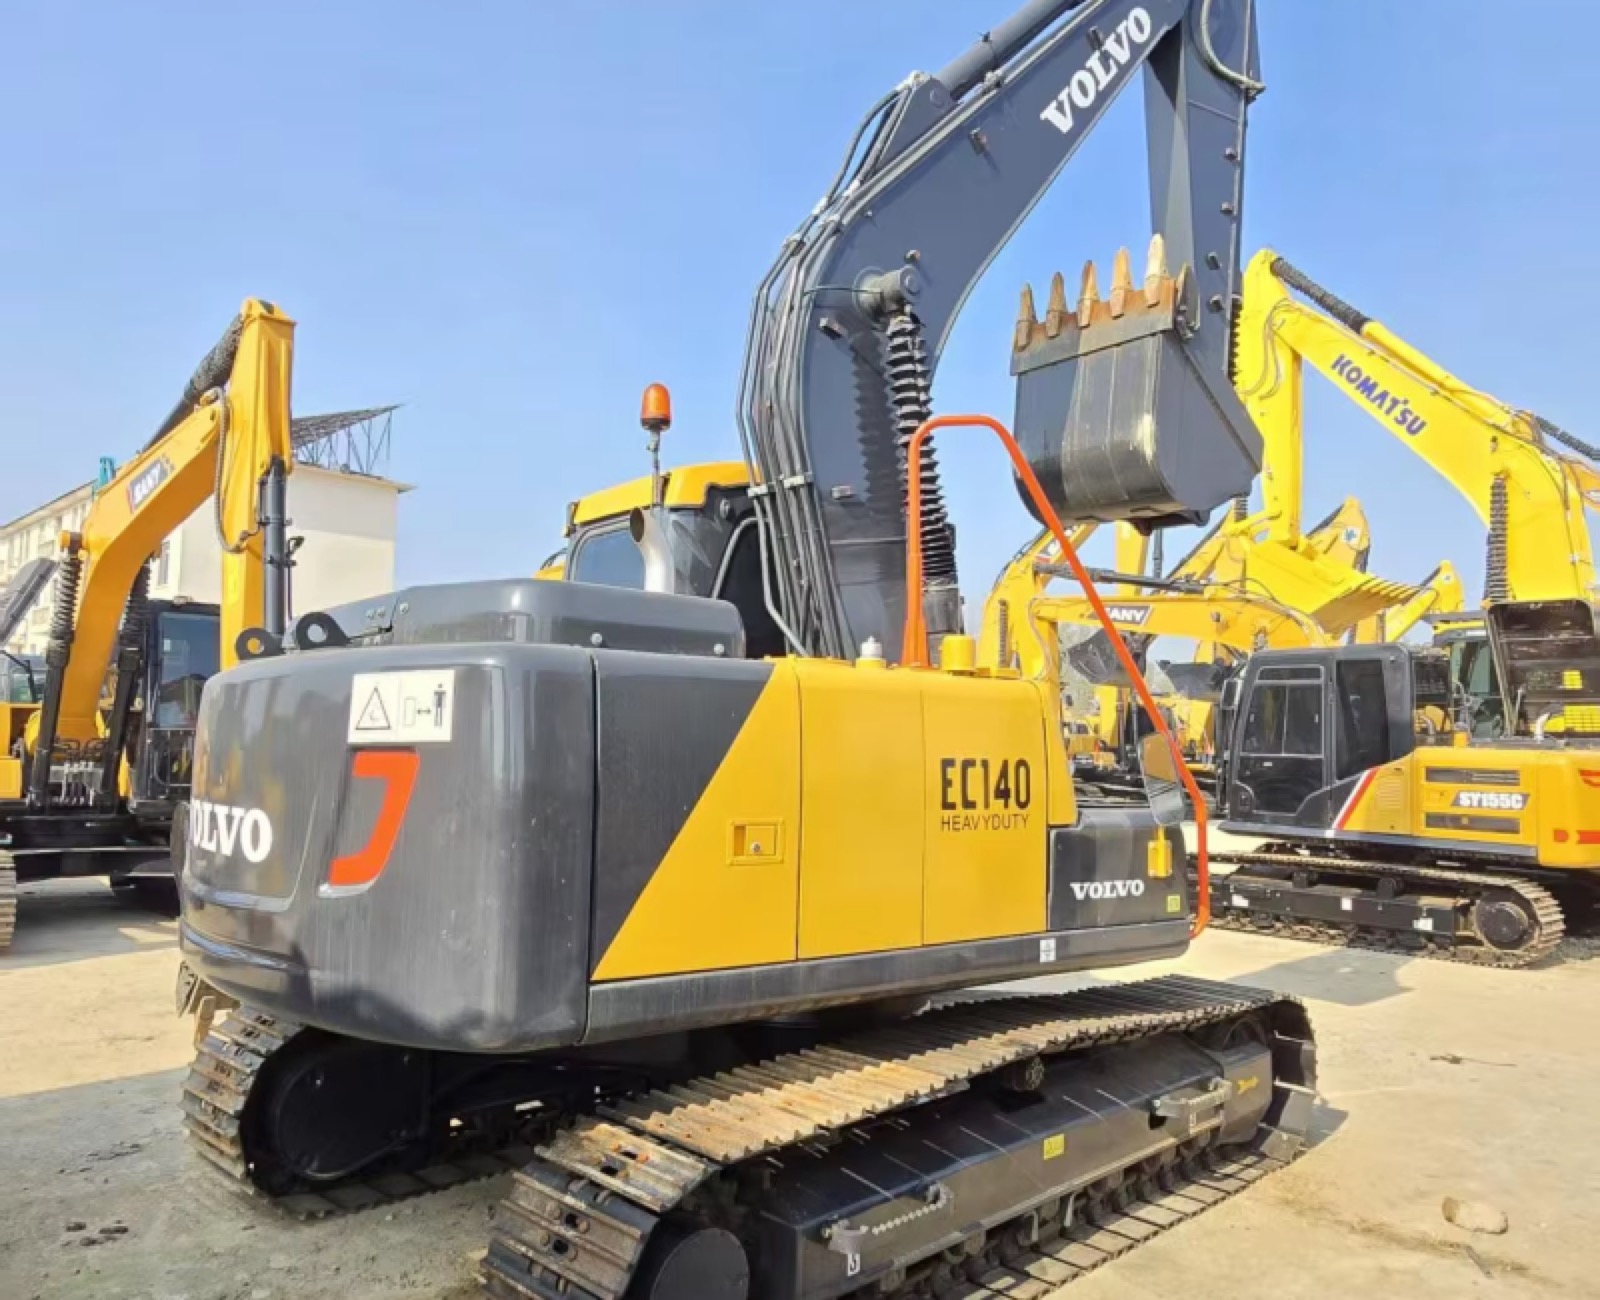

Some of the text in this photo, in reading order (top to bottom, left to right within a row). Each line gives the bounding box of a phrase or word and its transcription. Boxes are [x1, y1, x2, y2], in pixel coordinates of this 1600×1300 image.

[1040, 7, 1151, 134] VOLVO
[1331, 354, 1427, 436] KOMATSU
[1105, 606, 1145, 622] ANY
[941, 758, 1031, 811] EC140
[1459, 791, 1523, 809] SY155C
[189, 798, 272, 863] OLVO
[1070, 879, 1145, 900] VOLVO
